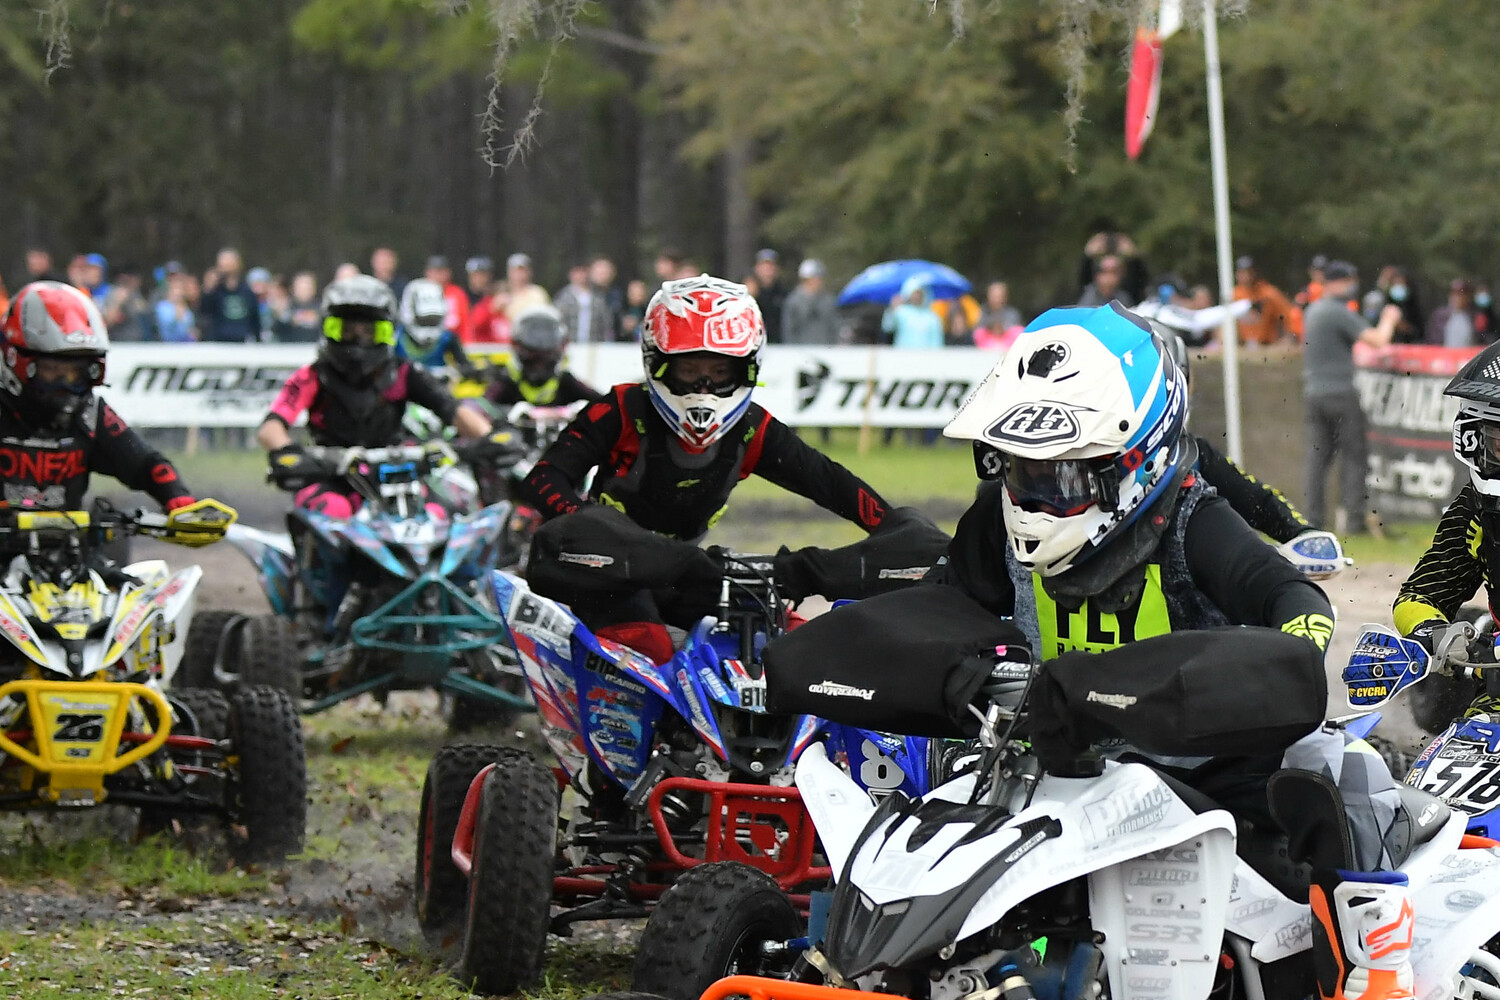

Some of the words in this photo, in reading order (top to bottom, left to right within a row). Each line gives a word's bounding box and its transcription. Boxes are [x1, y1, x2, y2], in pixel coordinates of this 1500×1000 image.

[125, 366, 290, 393] MOOS
[837, 379, 971, 409] THOR
[1055, 584, 1147, 644] FLY
[741, 687, 766, 706] 81
[1357, 687, 1387, 698] CYCRA
